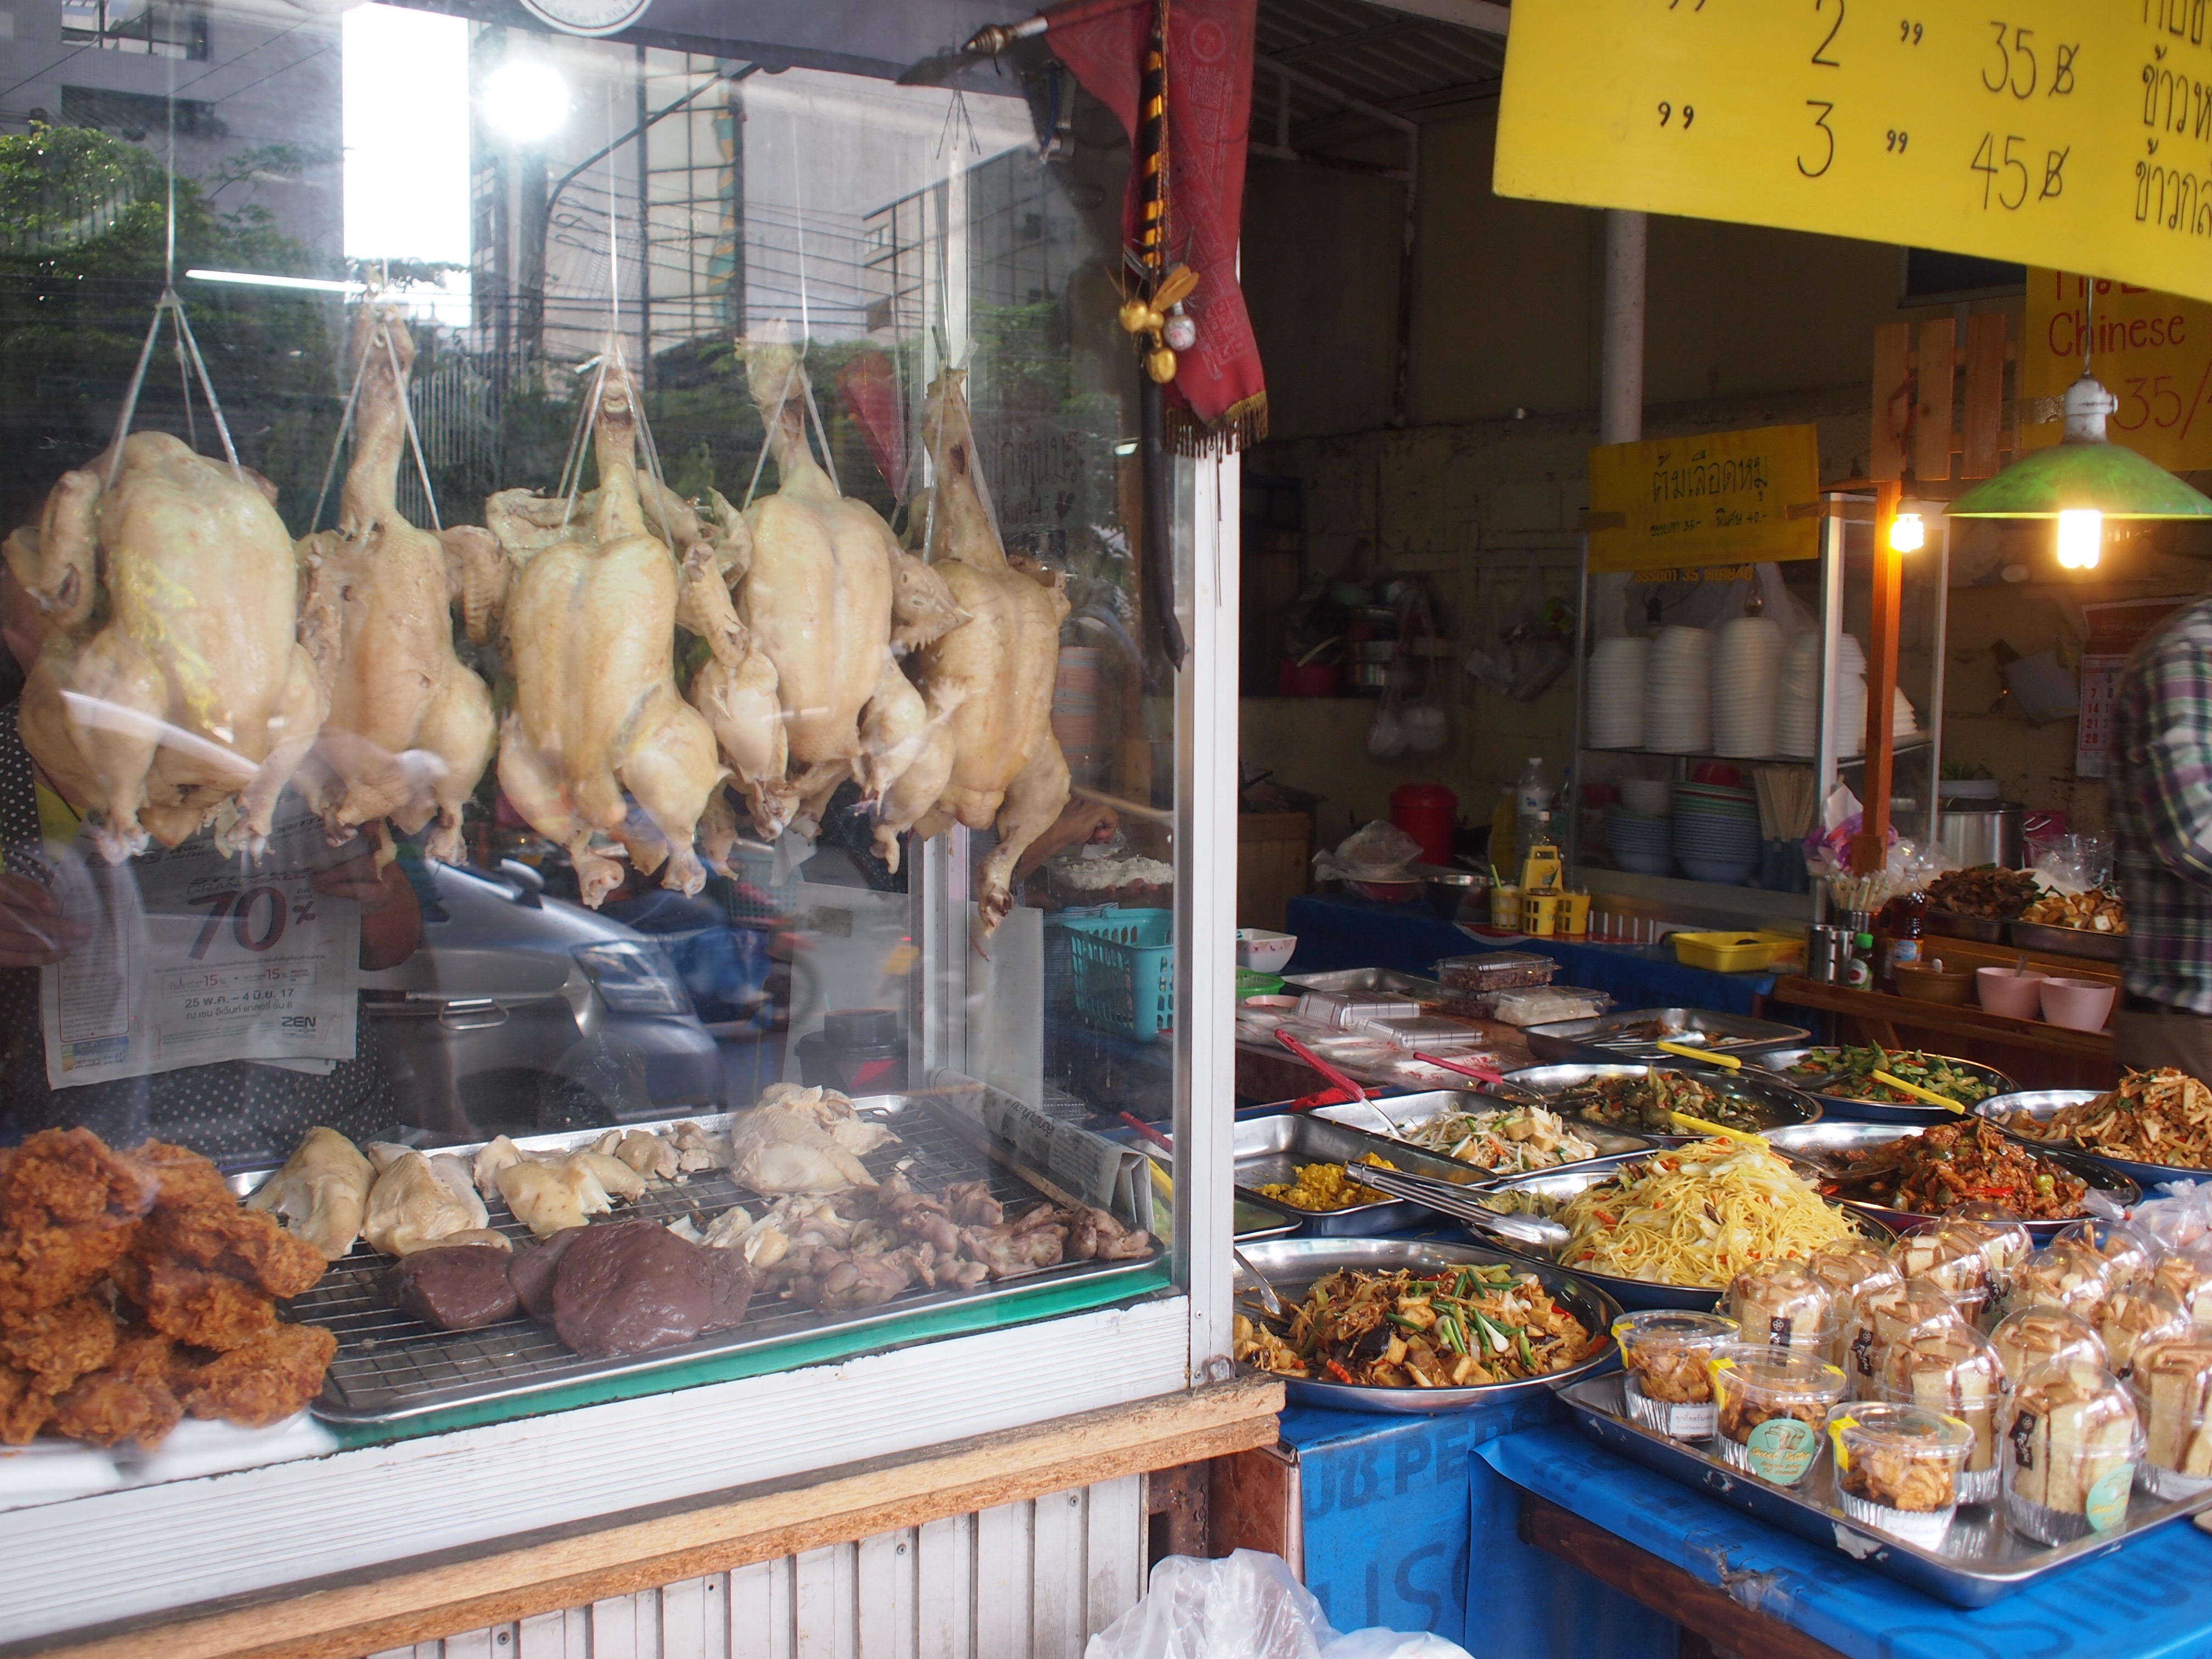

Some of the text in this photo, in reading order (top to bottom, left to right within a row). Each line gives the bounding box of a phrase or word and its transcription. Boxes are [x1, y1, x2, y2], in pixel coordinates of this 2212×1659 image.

[1812, 0, 1845, 67] 2
[1797, 99, 1834, 177] 3
[2049, 309, 2186, 357] Chinese
[1653, 449, 1768, 501] ต้มเลือดหมู
[2090, 687, 2097, 699] 7
[2087, 703, 2099, 714] 14
[2086, 718, 2098, 729] 21
[2085, 733, 2098, 744] 28
[185, 998, 200, 1008] 25
[242, 992, 250, 1001] 4
[280, 988, 295, 998] 17
[281, 1016, 317, 1028] ZEN
